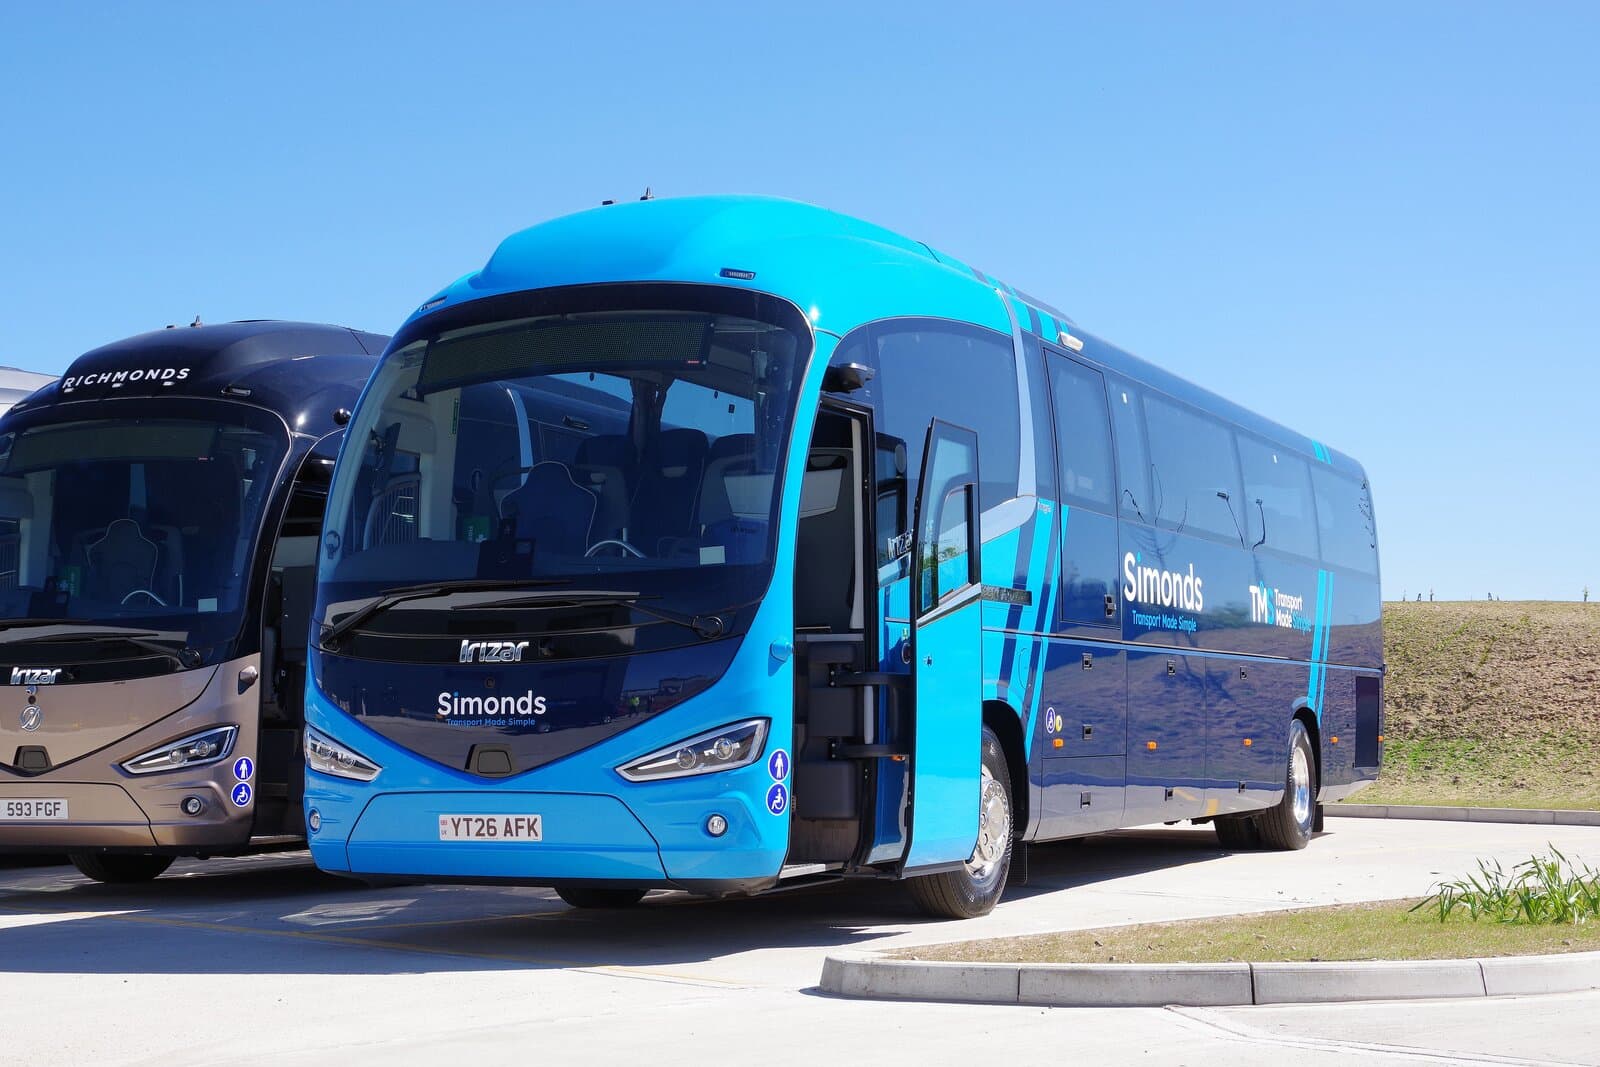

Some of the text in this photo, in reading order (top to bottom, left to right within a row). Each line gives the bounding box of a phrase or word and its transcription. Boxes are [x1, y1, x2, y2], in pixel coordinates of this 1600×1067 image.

[62, 367, 190, 389] RICHMONDS
[887, 529, 914, 560] Iriza
[1123, 551, 1203, 612] Simonds
[1249, 581, 1275, 625] TMS
[1274, 588, 1303, 613] Transport
[1132, 609, 1197, 635] Transport Made Simple
[1276, 608, 1293, 628] Made
[459, 639, 530, 663] Irizar
[10, 666, 63, 685] Irizar
[437, 689, 547, 716] Simonds
[446, 718, 536, 728] Transport Made Simple
[7, 802, 62, 817] 593 FGF
[451, 817, 539, 837] YT26 AFK
